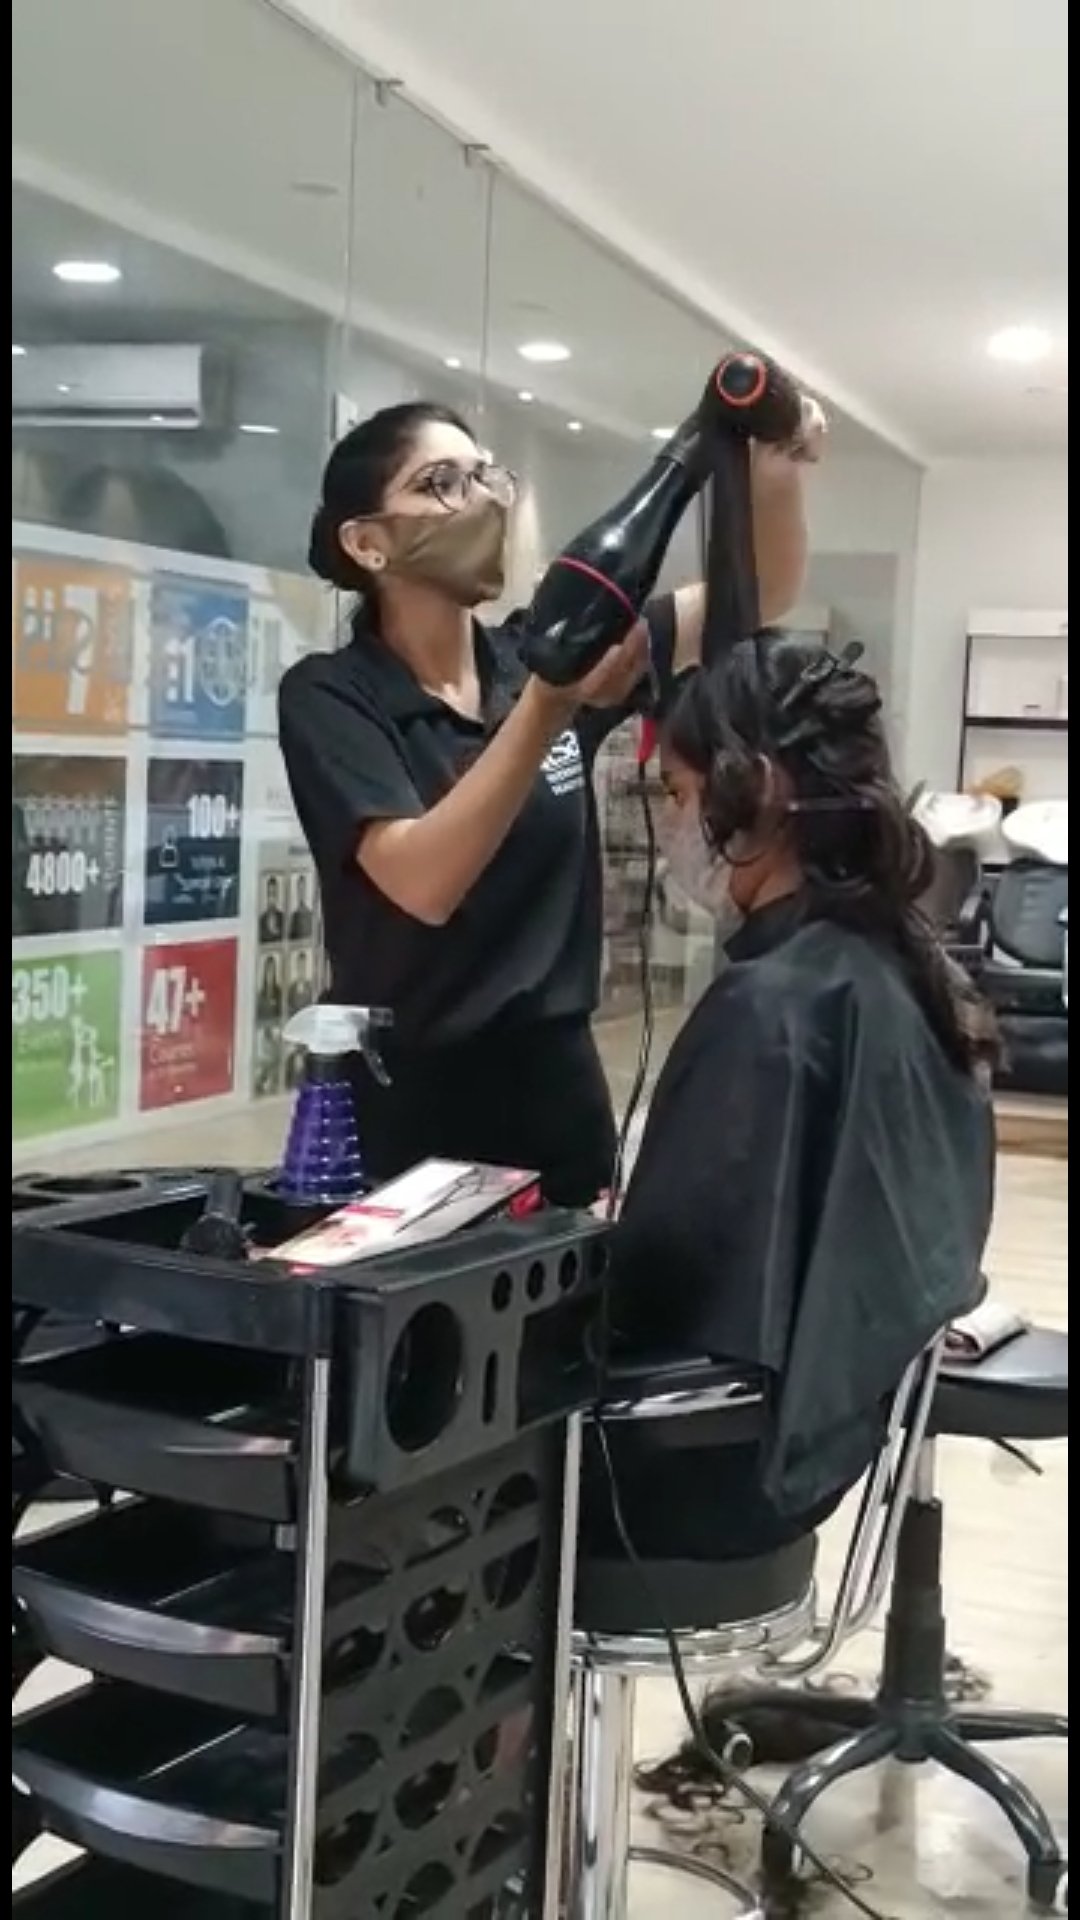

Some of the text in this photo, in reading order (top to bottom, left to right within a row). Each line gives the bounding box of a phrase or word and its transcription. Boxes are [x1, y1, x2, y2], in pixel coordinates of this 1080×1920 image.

[188, 794, 240, 838] 100+
[26, 850, 100, 896] 4800+
[12, 964, 88, 1025] 350+
[147, 965, 206, 1035] 47+
